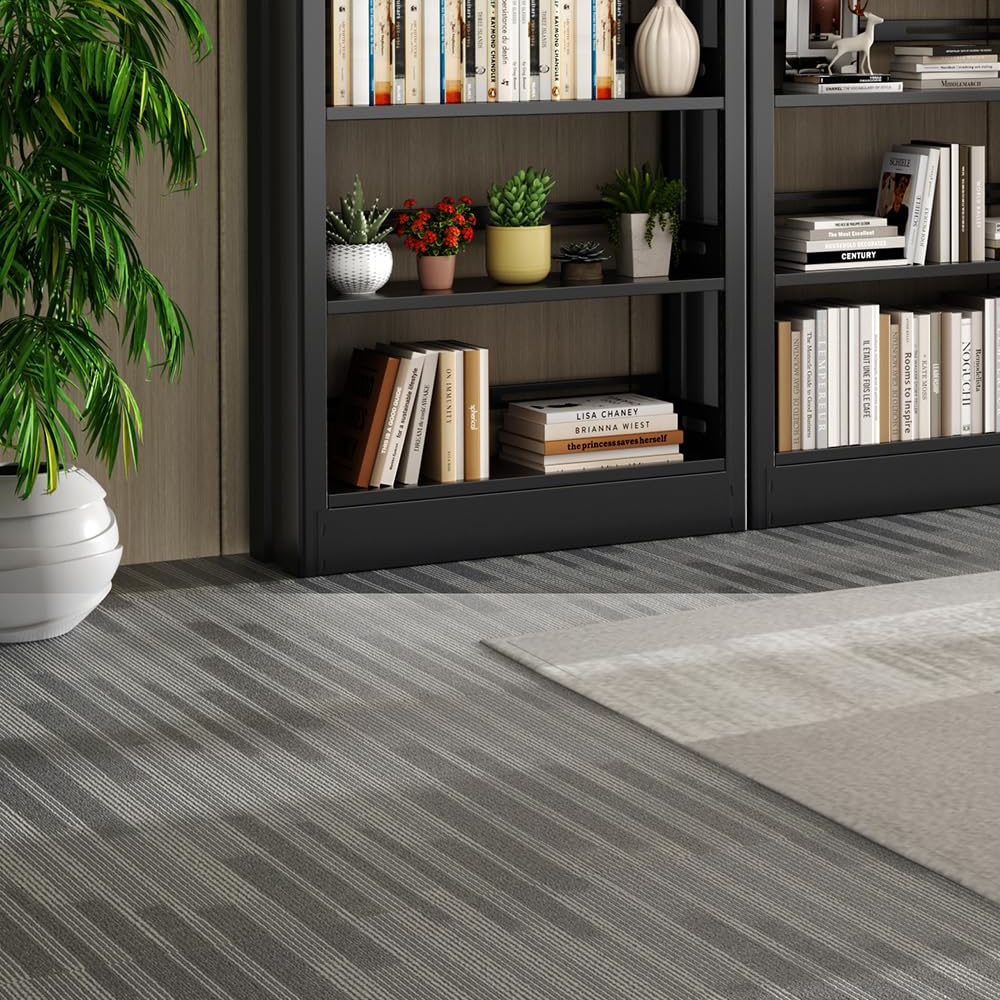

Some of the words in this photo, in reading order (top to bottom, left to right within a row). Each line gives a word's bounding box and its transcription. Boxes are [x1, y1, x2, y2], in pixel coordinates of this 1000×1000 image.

[502, 35, 509, 44] du
[841, 251, 876, 260] CENTURY
[446, 368, 452, 378] ON
[962, 342, 970, 406] NOGUCHI
[398, 390, 412, 424] sustainable
[408, 367, 419, 390] lifestyle
[905, 388, 912, 398] to
[413, 427, 424, 452] DREAM
[420, 384, 430, 407] AWAKE
[576, 411, 598, 420] LISA
[601, 408, 639, 418] CHANEY
[904, 400, 912, 434] Inspire
[380, 438, 389, 454] THIS
[387, 406, 397, 426] GOOD
[575, 424, 618, 434] BRIANNA
[622, 421, 650, 430] WIEST
